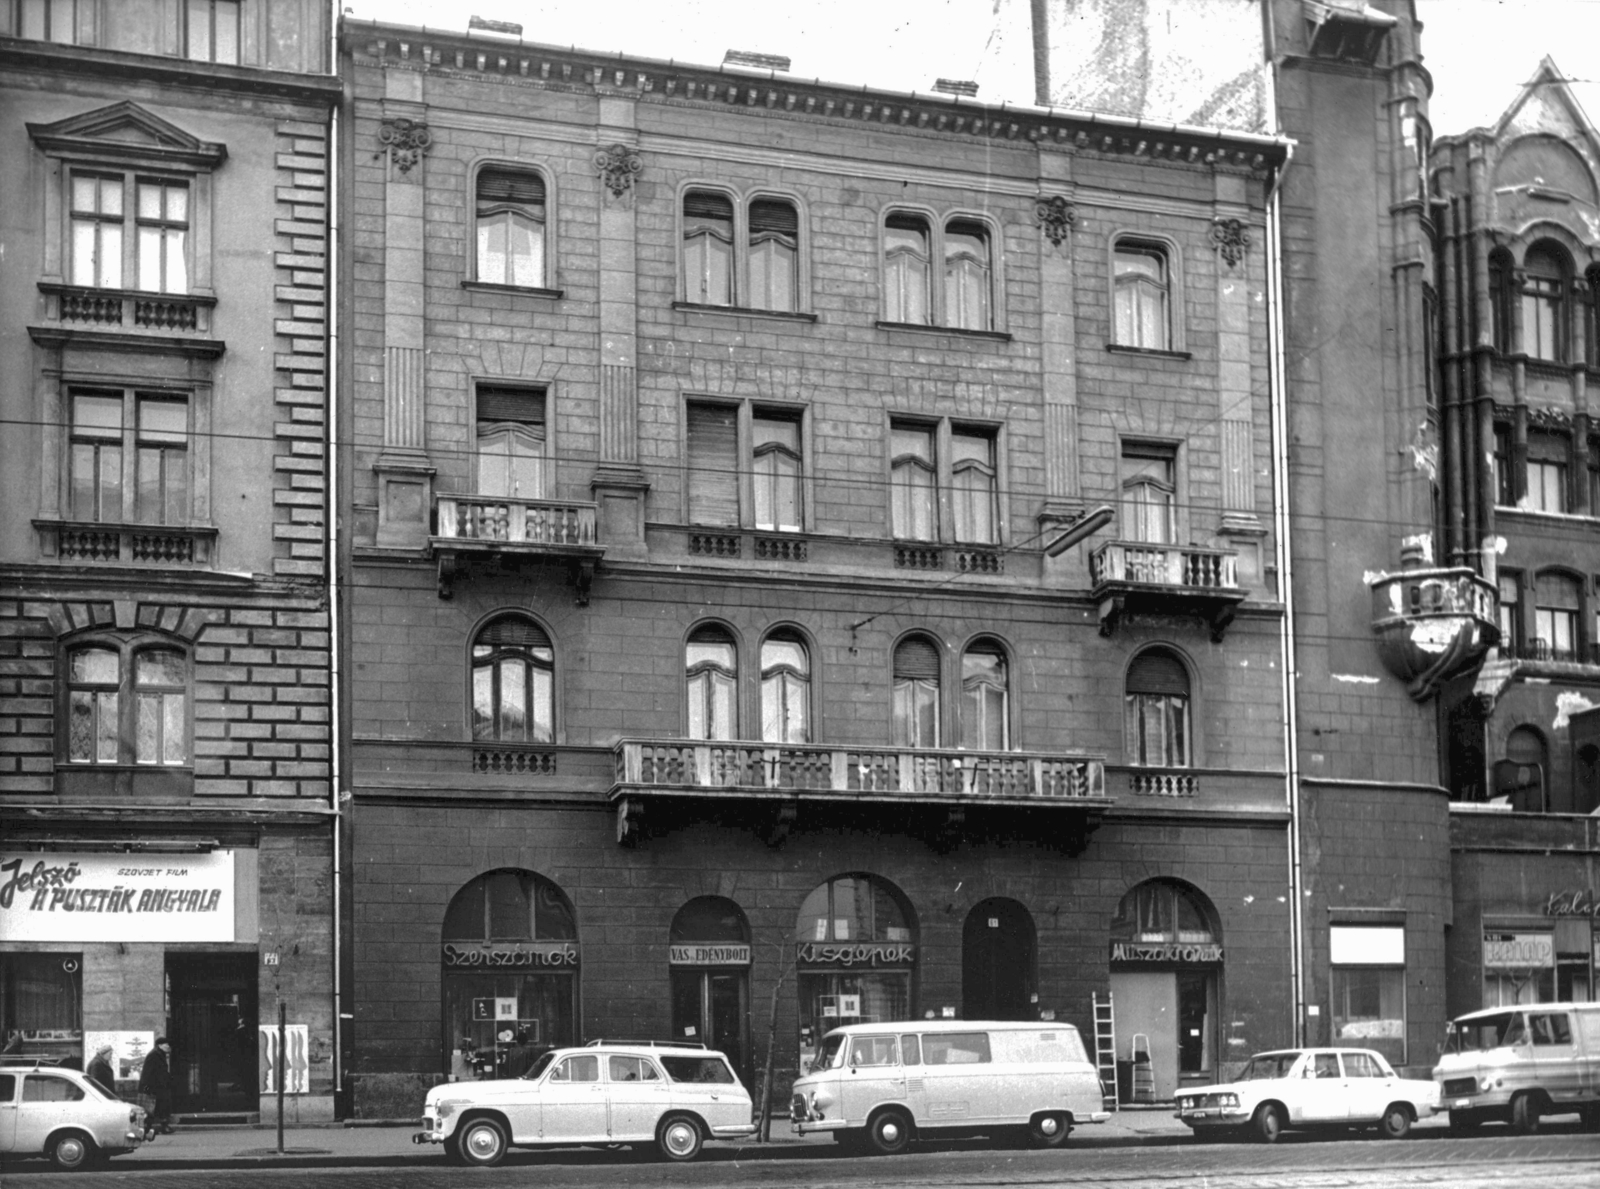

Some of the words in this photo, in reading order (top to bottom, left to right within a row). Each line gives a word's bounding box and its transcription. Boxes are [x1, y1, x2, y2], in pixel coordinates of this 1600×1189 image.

[117, 868, 163, 877] SZOVJET
[166, 868, 188, 877] FILM
[29, 887, 49, 912] A
[136, 887, 223, 914] ANGYALA
[444, 942, 578, 966] Szerszámok
[671, 948, 690, 961] VAS
[695, 946, 749, 961] EDÉNYBOLT
[796, 942, 914, 967] Kisgépek
